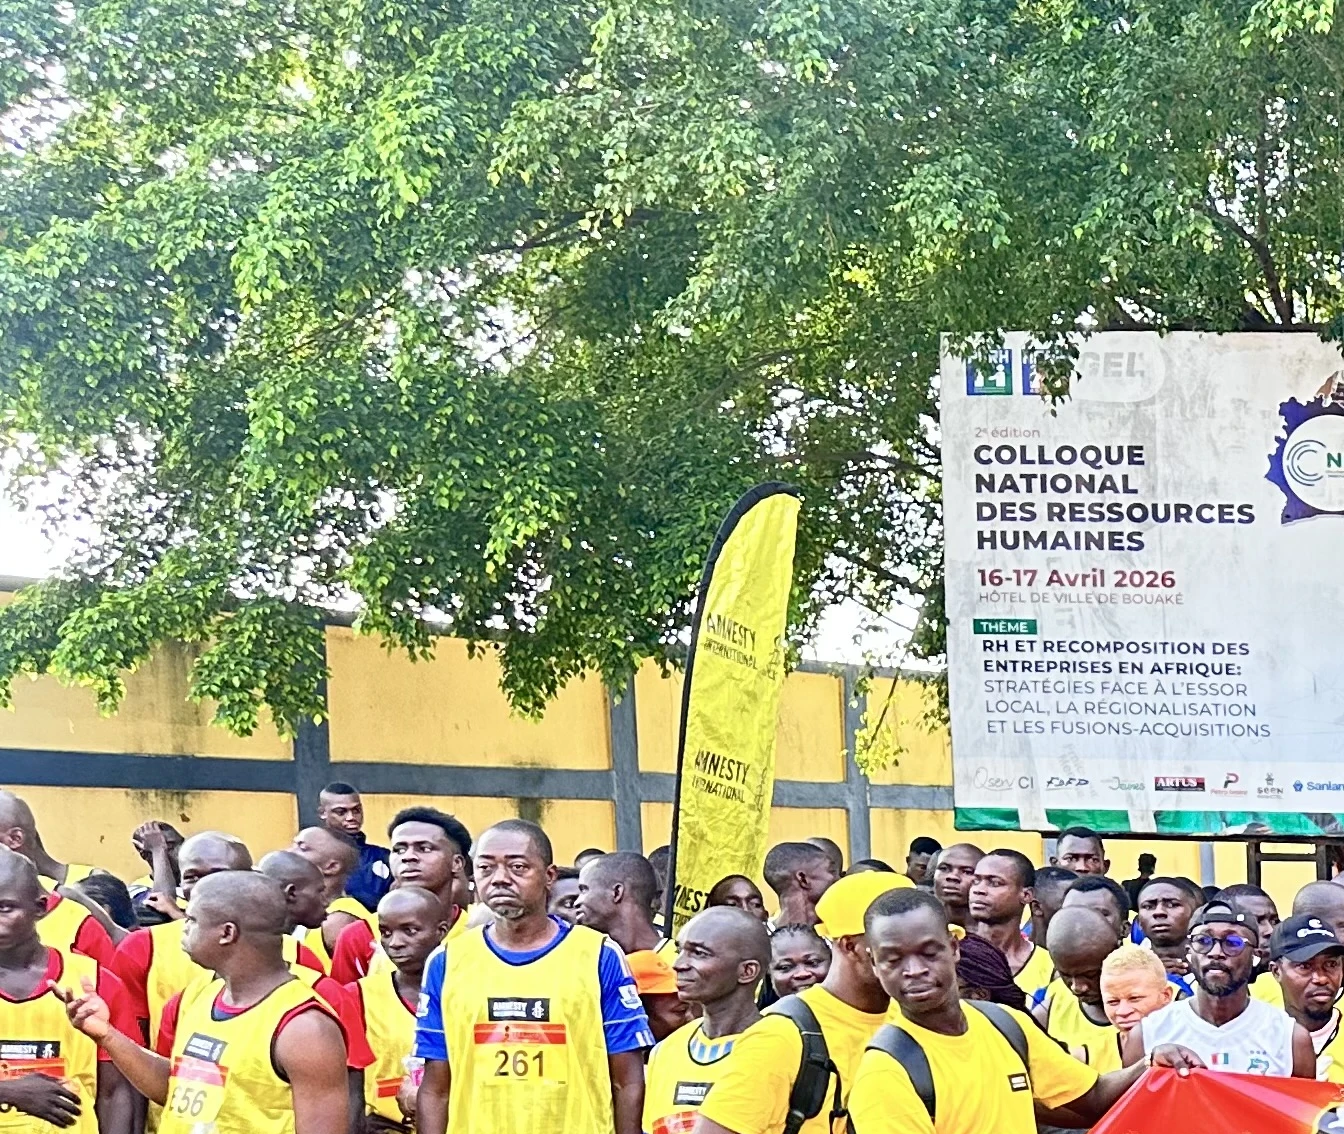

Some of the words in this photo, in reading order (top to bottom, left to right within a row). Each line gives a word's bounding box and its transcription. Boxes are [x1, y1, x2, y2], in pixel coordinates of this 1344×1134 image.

[991, 427, 1040, 438] édition
[974, 444, 1145, 469] COLLOQUE
[975, 473, 1138, 494] NATIONAL
[976, 502, 1037, 521] DES
[1047, 503, 1256, 524] RESSOURCES
[977, 530, 1145, 551] HUMAINES
[978, 569, 1038, 587] 16-17
[1046, 568, 1105, 587] Avril
[1114, 570, 1176, 588] 2026
[979, 591, 1026, 604] HÔTEL
[1030, 592, 1050, 604] DE
[1053, 593, 1093, 604] VILLE
[1098, 593, 1117, 604] DE
[1122, 591, 1184, 605] BOUAKÉ
[980, 620, 1028, 633] THÈME
[982, 640, 1009, 652] RH
[1016, 640, 1038, 652] ET
[1043, 641, 1206, 655] RECOMPOSITION
[1212, 643, 1250, 655] DES
[983, 660, 1112, 674] ENTREPRISES
[1119, 662, 1143, 674] EN
[1150, 663, 1242, 677] AFRIQUE:
[984, 678, 1095, 694] STRATÉGIES
[1101, 681, 1149, 695] FACE
[1154, 679, 1167, 695] À
[1173, 682, 1247, 696] L’ESSOR
[986, 700, 1050, 715] LOCAL,
[1056, 701, 1079, 715] LA
[1085, 699, 1256, 716] RÉGIONALISATION
[987, 721, 1006, 733] ET
[1013, 721, 1045, 734] LES
[1051, 722, 1270, 738] FUSIONS-ACQUISITIONS
[494, 1049, 545, 1077] 261
